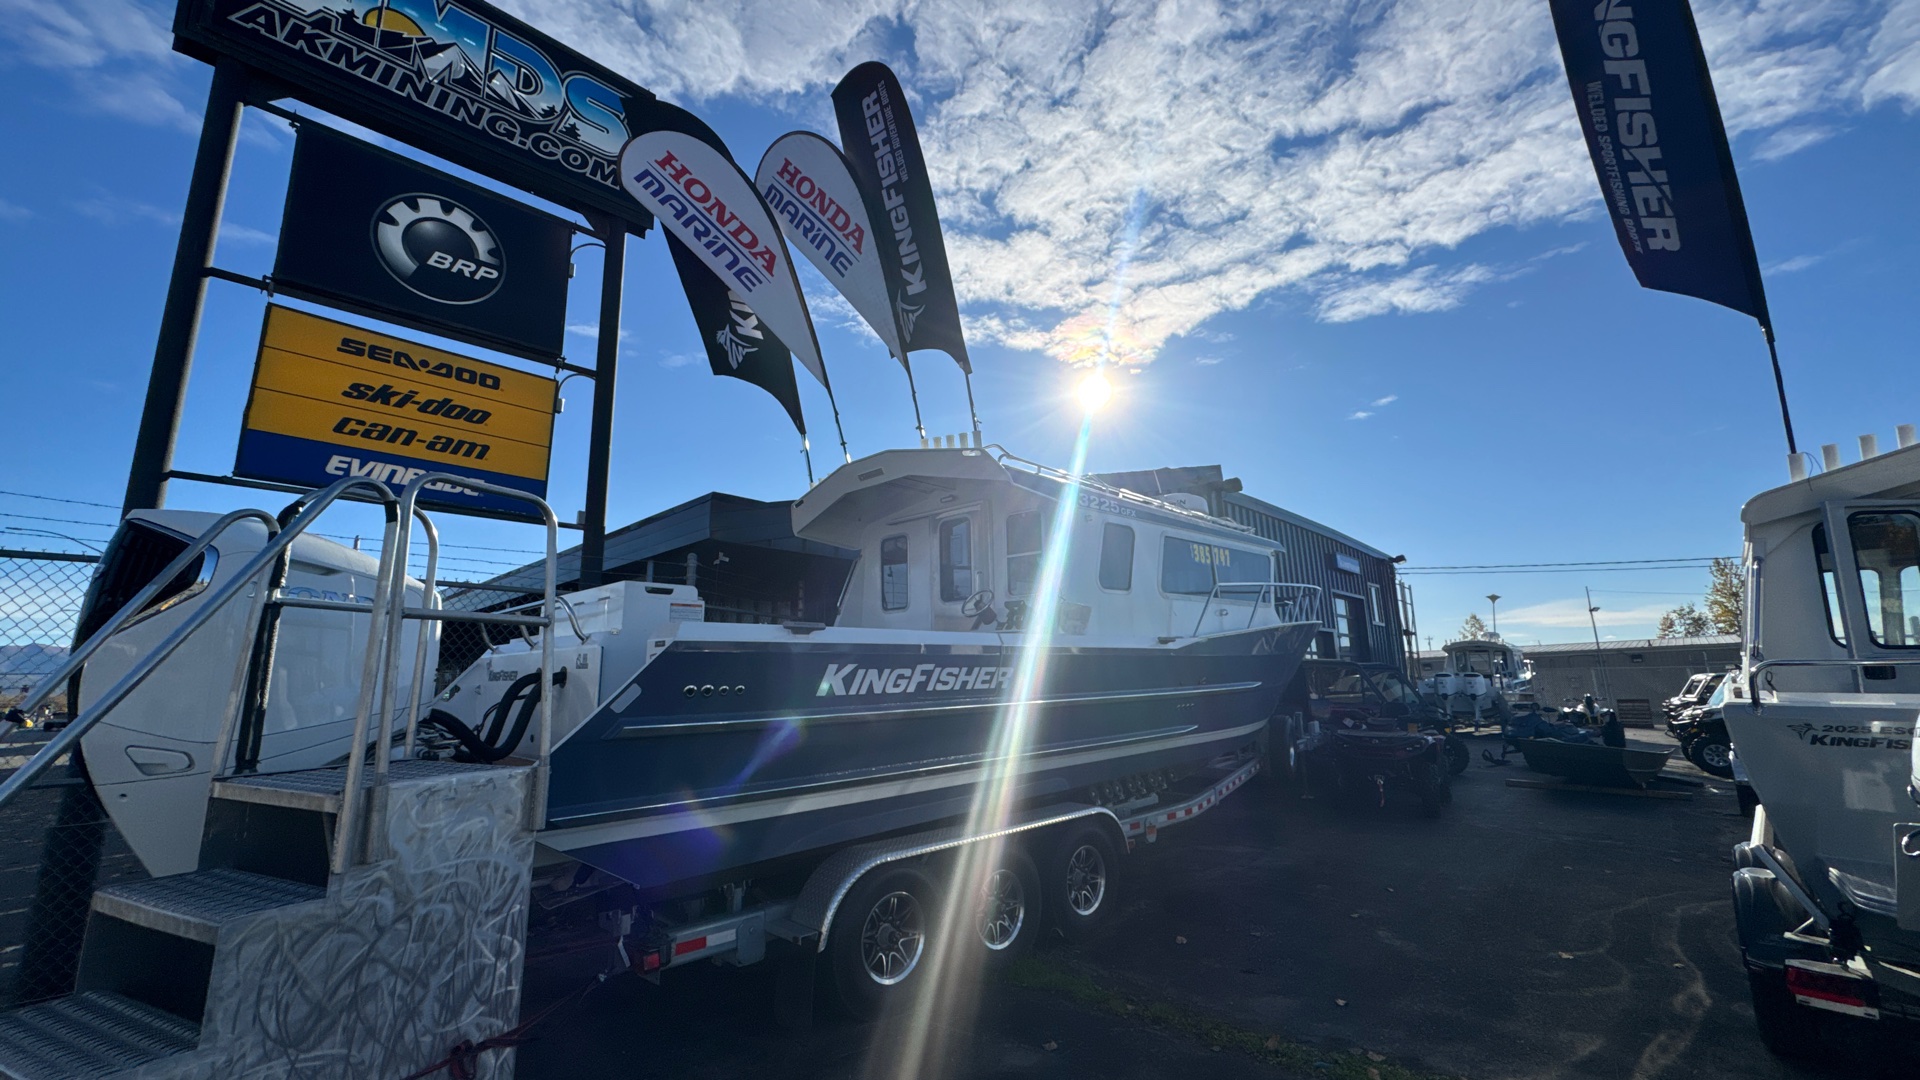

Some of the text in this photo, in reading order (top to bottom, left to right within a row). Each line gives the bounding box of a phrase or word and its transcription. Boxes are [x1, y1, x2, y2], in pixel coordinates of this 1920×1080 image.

[227, 2, 621, 191] AKMINING.COM
[877, 79, 909, 183] WELDED ADVENTURE BOATS
[861, 89, 928, 297] KINGFISHER
[1587, 81, 1608, 133] WELDED
[1598, 135, 1631, 216] SPORTFISHING
[633, 168, 764, 293] MARINE
[654, 150, 780, 278] HONDA
[763, 183, 853, 279] MARINE
[776, 157, 866, 255] HONDA
[426, 250, 499, 281] BRP
[332, 416, 491, 460] can-am
[341, 381, 492, 425] ski-doo
[1078, 492, 1120, 514] 3225
[816, 663, 1014, 697] KINGFISHER
[1809, 734, 1912, 750] KINGFIS
[1821, 724, 1872, 734] 2025
